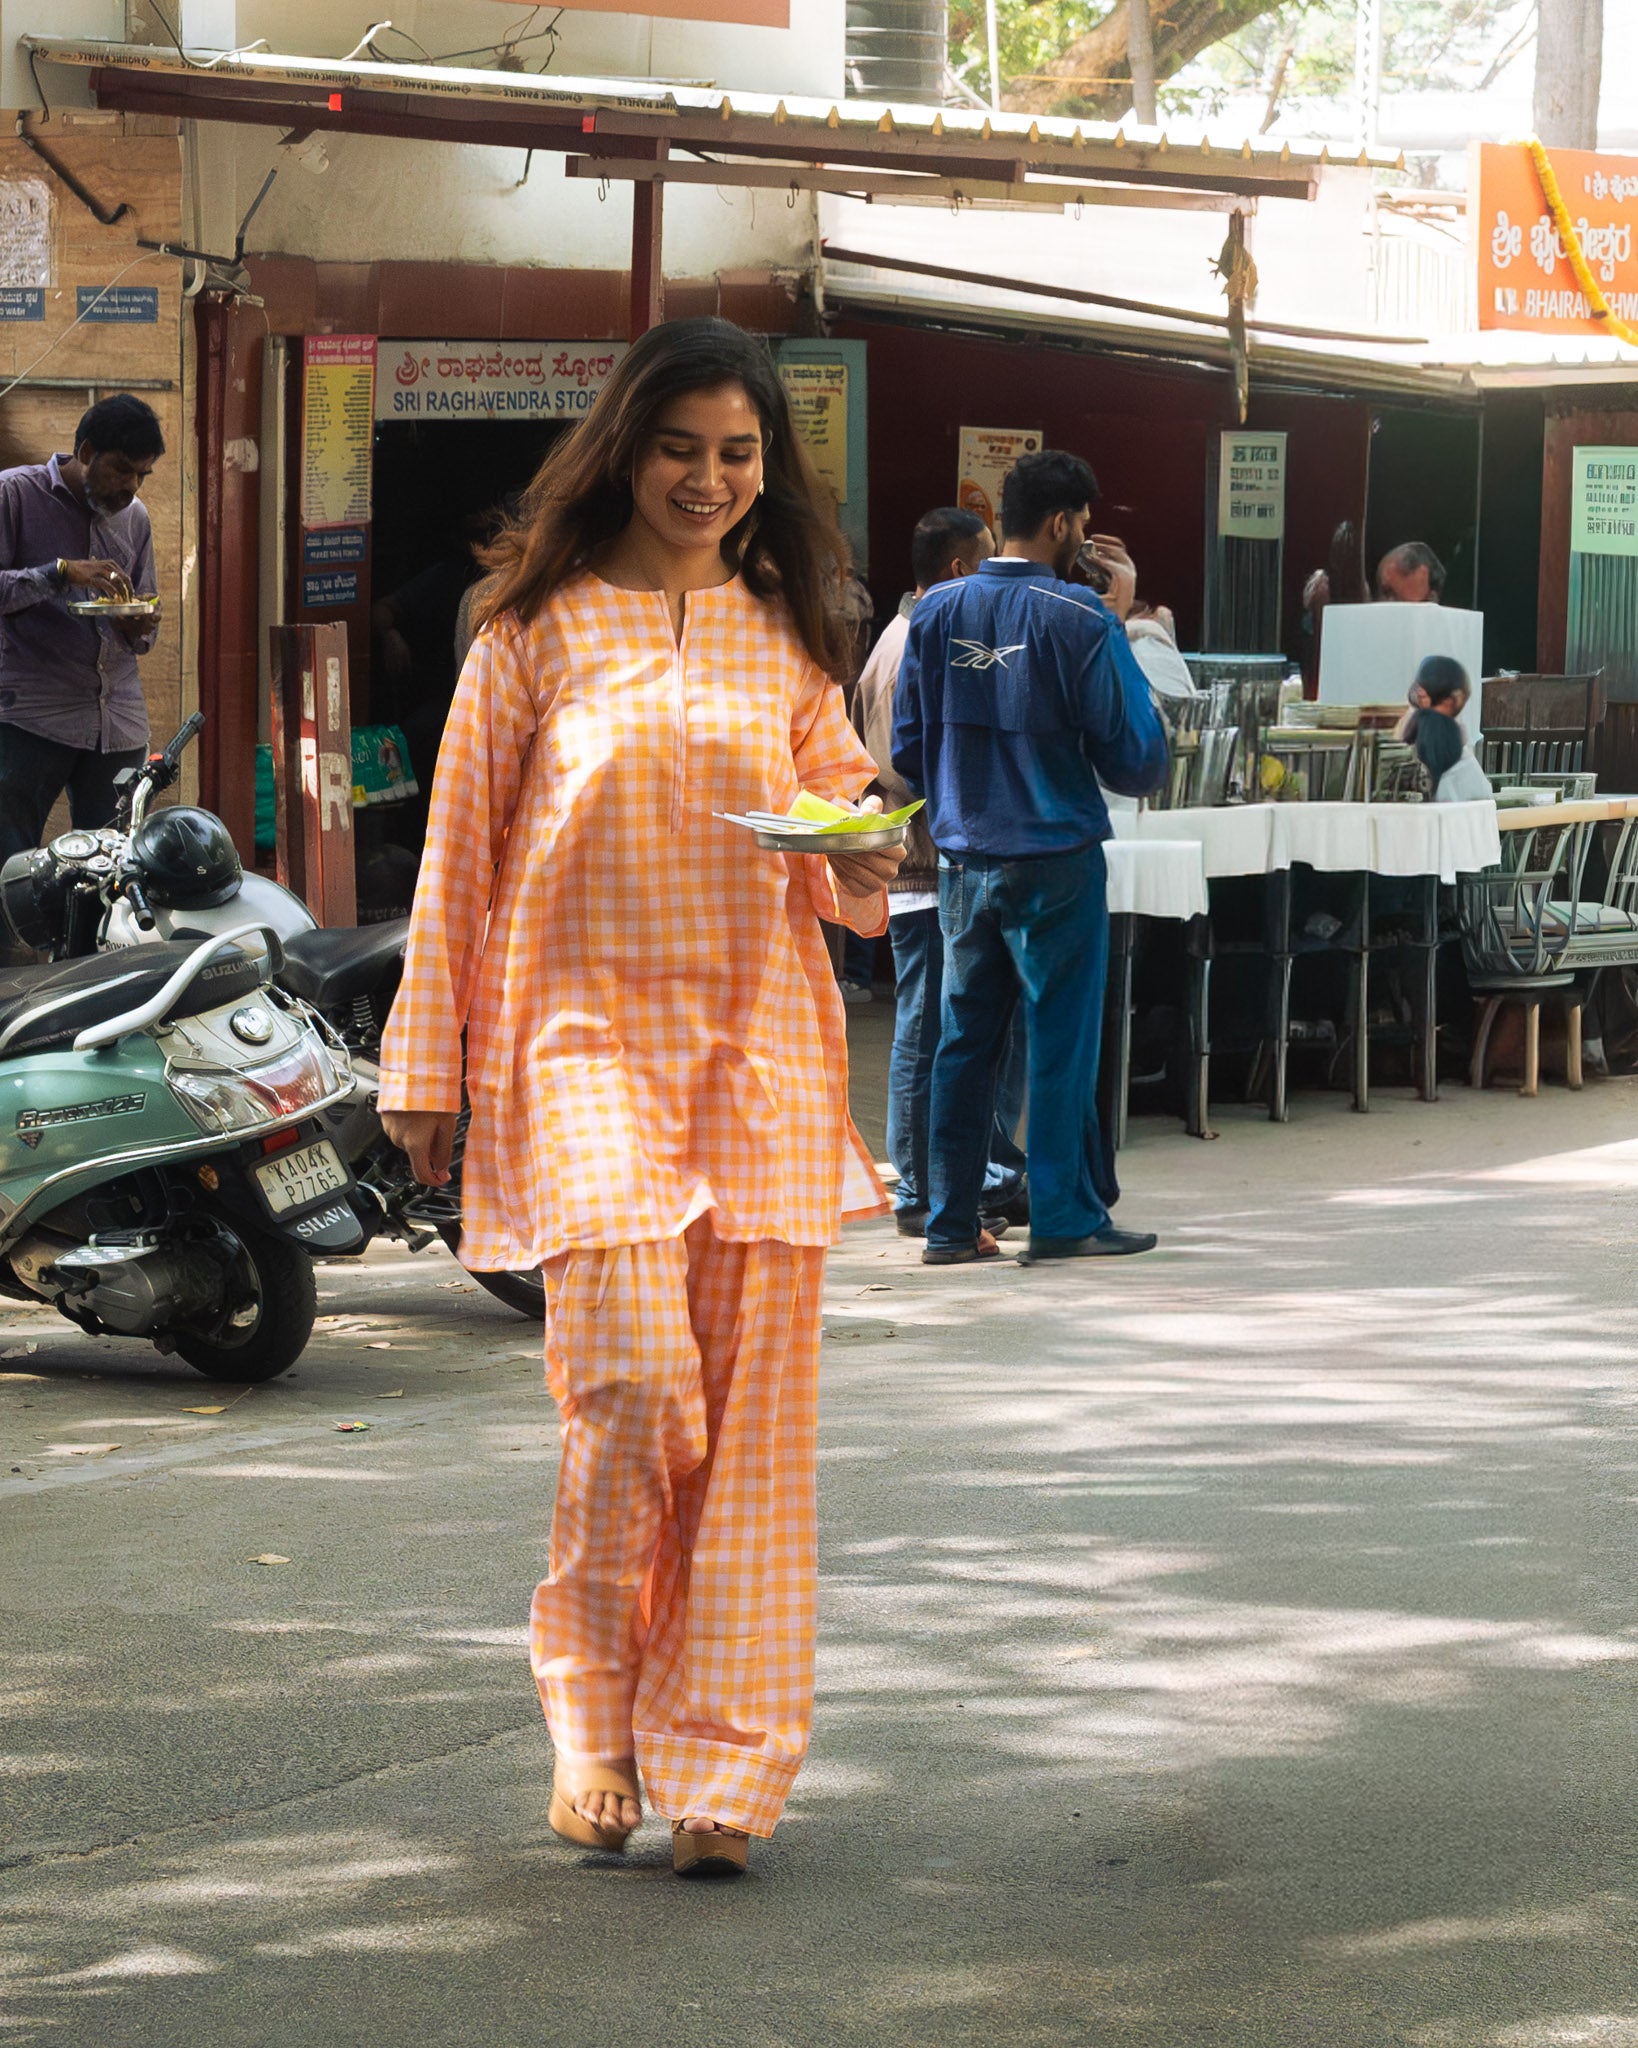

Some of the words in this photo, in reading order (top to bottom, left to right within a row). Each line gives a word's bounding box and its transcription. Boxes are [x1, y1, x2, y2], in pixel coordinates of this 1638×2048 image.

[503, 88, 539, 100] PANELS
[396, 351, 430, 386] ಶ್ರೀ
[437, 350, 547, 385] ರಾಘವೇಂದ್ರ
[393, 391, 420, 412] SRI
[426, 390, 551, 412] RAGHAVENDRA
[284, 1167, 340, 1205] P7765
